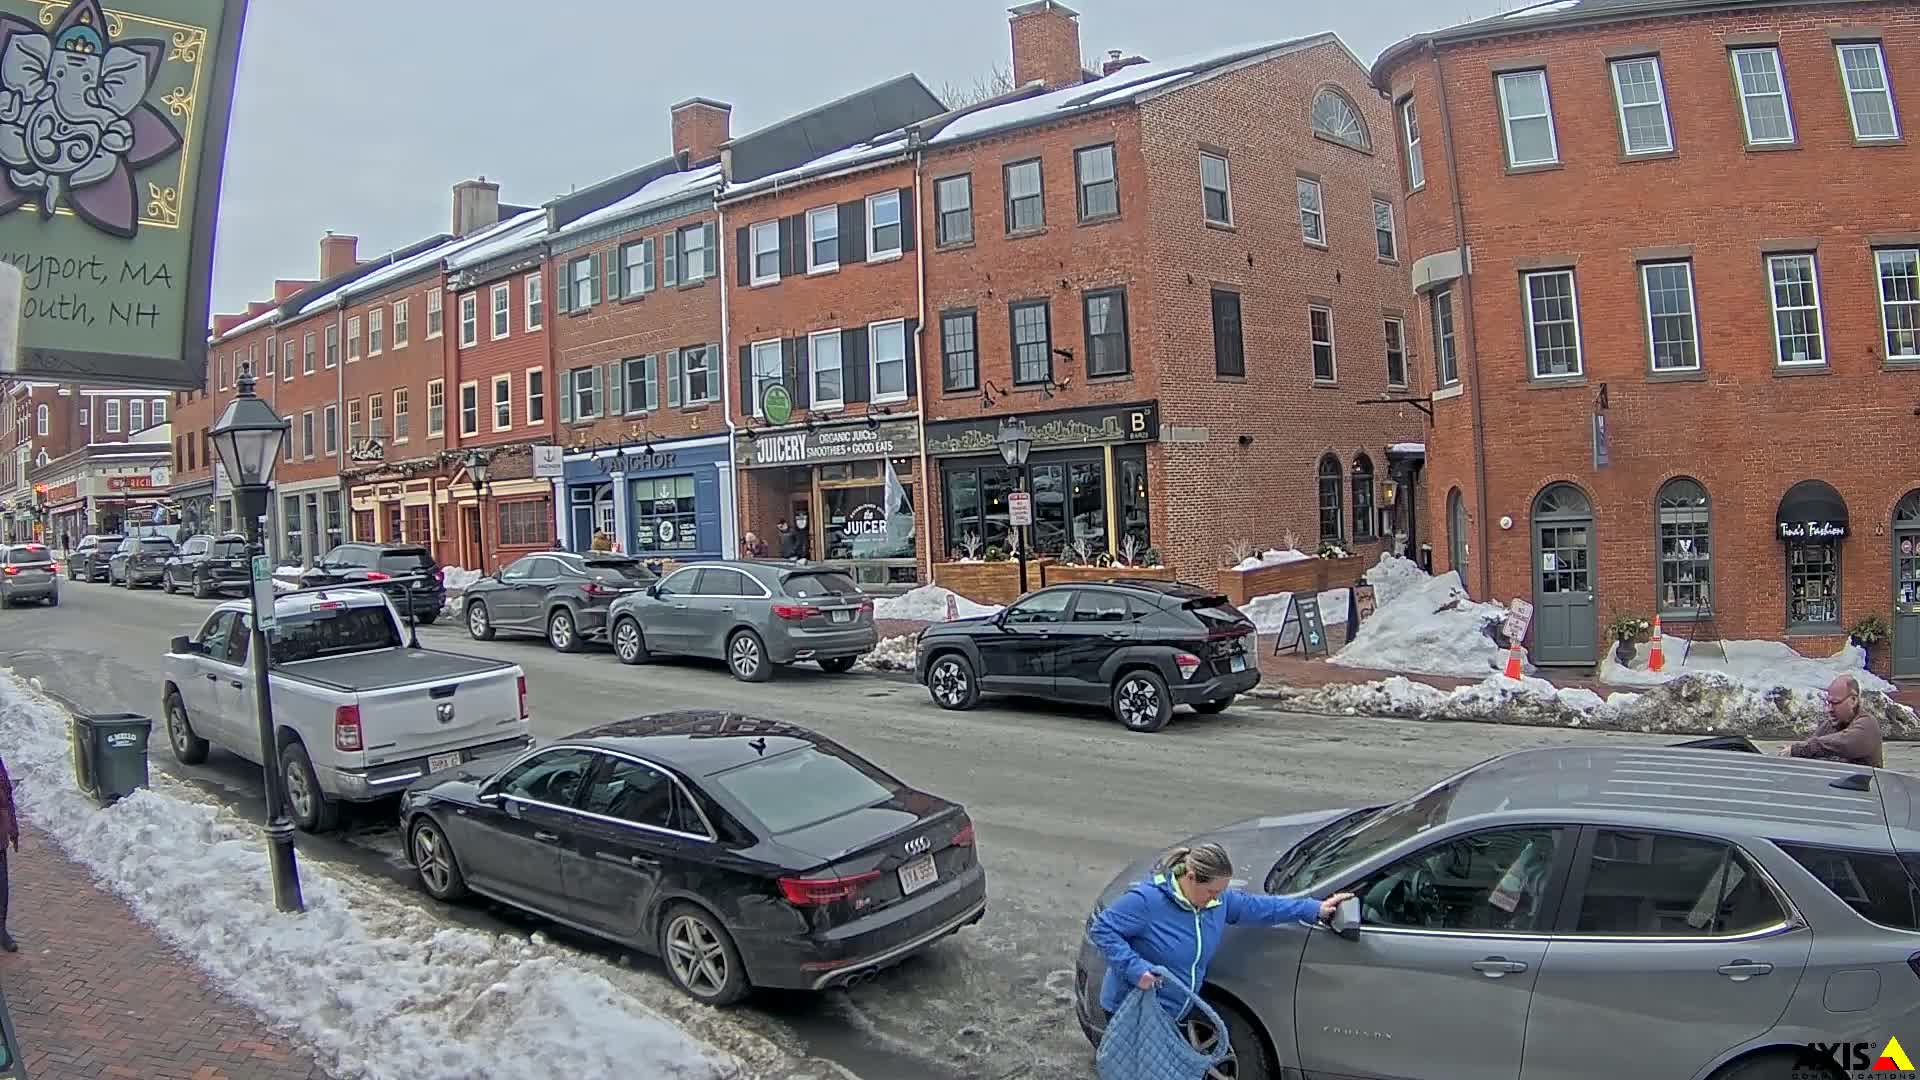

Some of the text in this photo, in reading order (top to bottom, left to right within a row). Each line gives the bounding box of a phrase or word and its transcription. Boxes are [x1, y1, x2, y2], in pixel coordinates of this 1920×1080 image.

[0, 252, 172, 291] ryport, MA
[108, 301, 160, 329] NH
[1131, 412, 1145, 432] B
[818, 429, 878, 444] ORGANIC JUICES
[757, 433, 807, 463] JUICERY
[806, 440, 894, 458] SMOOTHIES GOOD EATS
[609, 452, 677, 472] ANCHOR
[1780, 522, 1805, 537] Tina's
